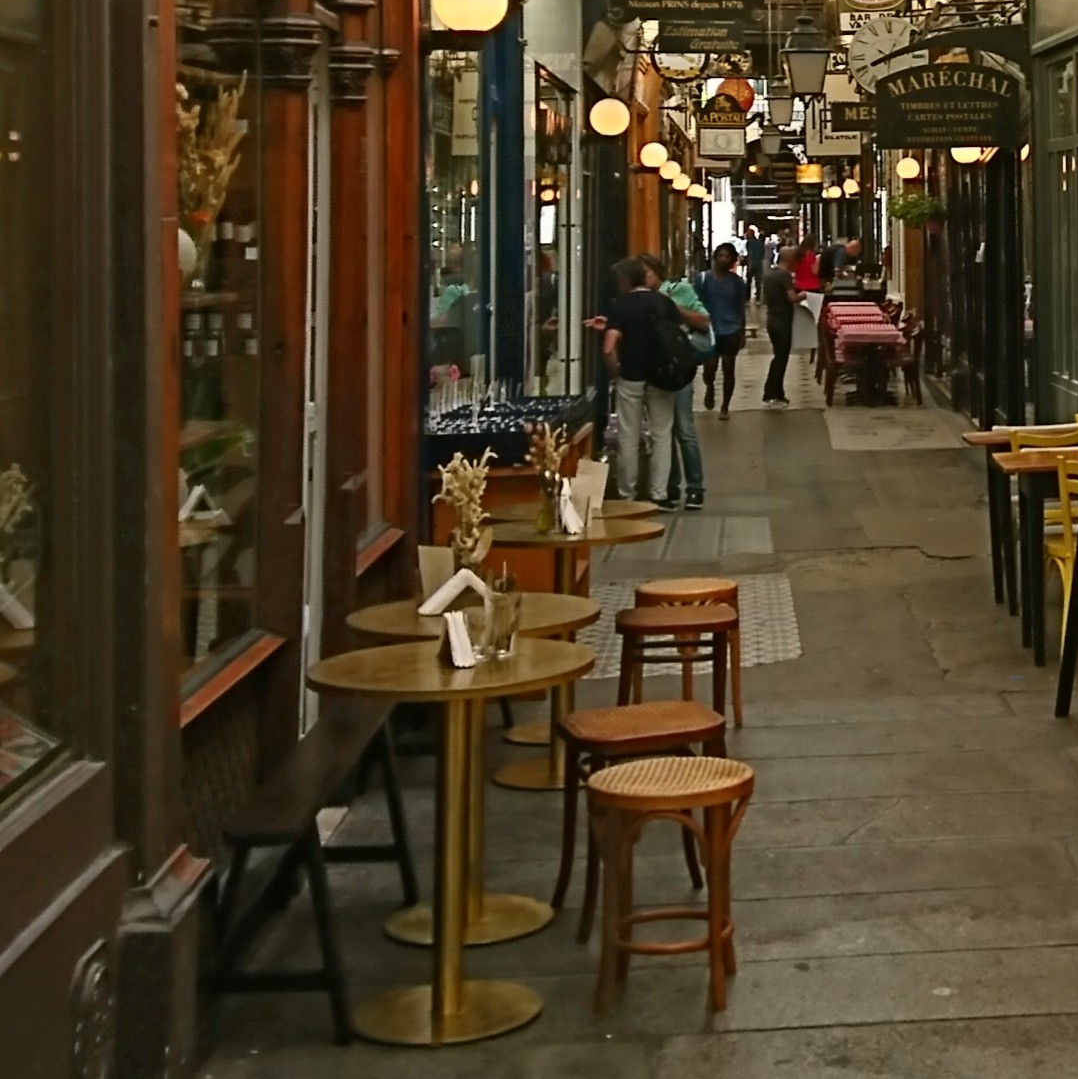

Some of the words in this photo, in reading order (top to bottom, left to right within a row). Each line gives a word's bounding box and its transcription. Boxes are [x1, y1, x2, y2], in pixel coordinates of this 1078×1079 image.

[628, 0, 660, 9] Maison
[690, 0, 720, 11] depuis
[850, 13, 871, 21] BAR
[663, 25, 729, 37] Estimation
[887, 65, 1013, 98] MARÉCHAL
